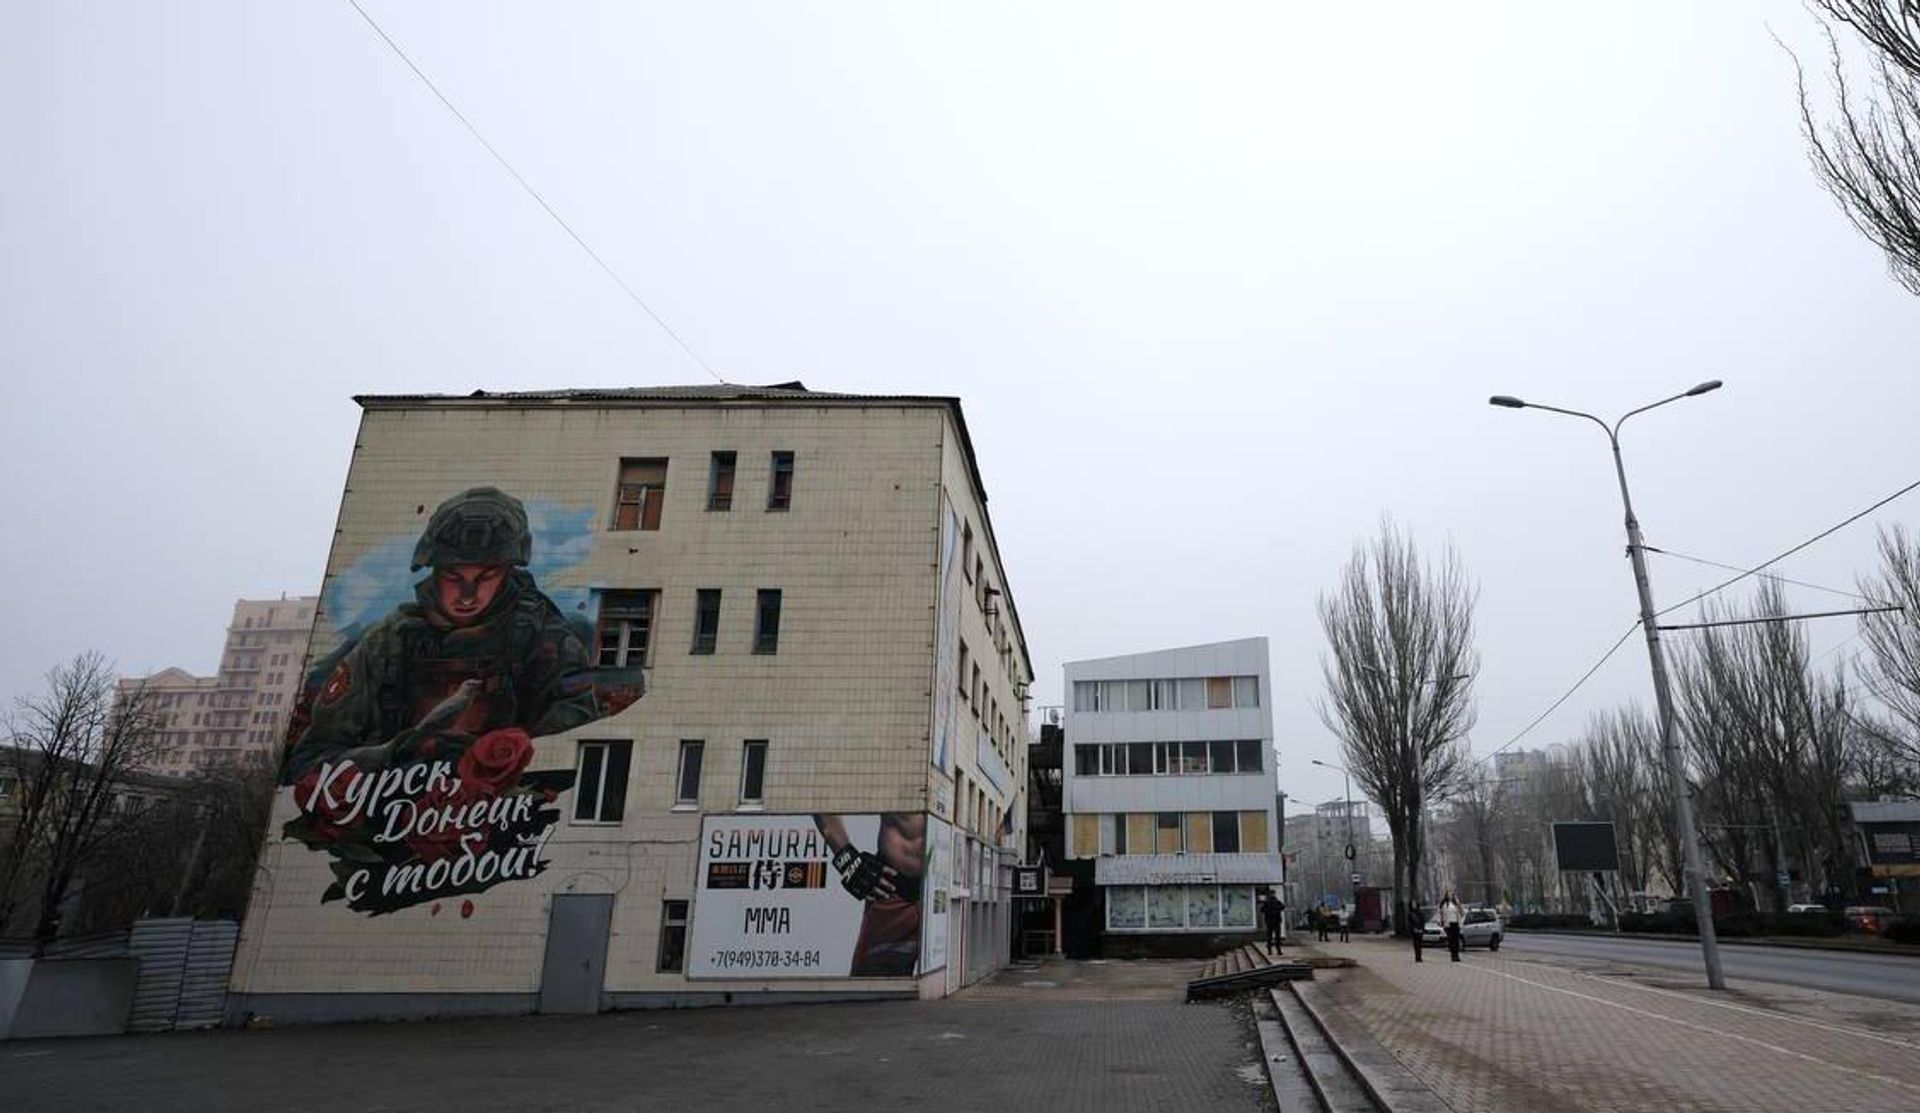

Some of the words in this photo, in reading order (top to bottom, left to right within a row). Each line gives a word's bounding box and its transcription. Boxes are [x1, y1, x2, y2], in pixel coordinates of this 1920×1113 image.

[305, 760, 462, 825] Курск,
[373, 793, 533, 843] Донецк
[346, 869, 370, 901] с
[382, 824, 555, 896] тобой!
[744, 907, 790, 934] MMA
